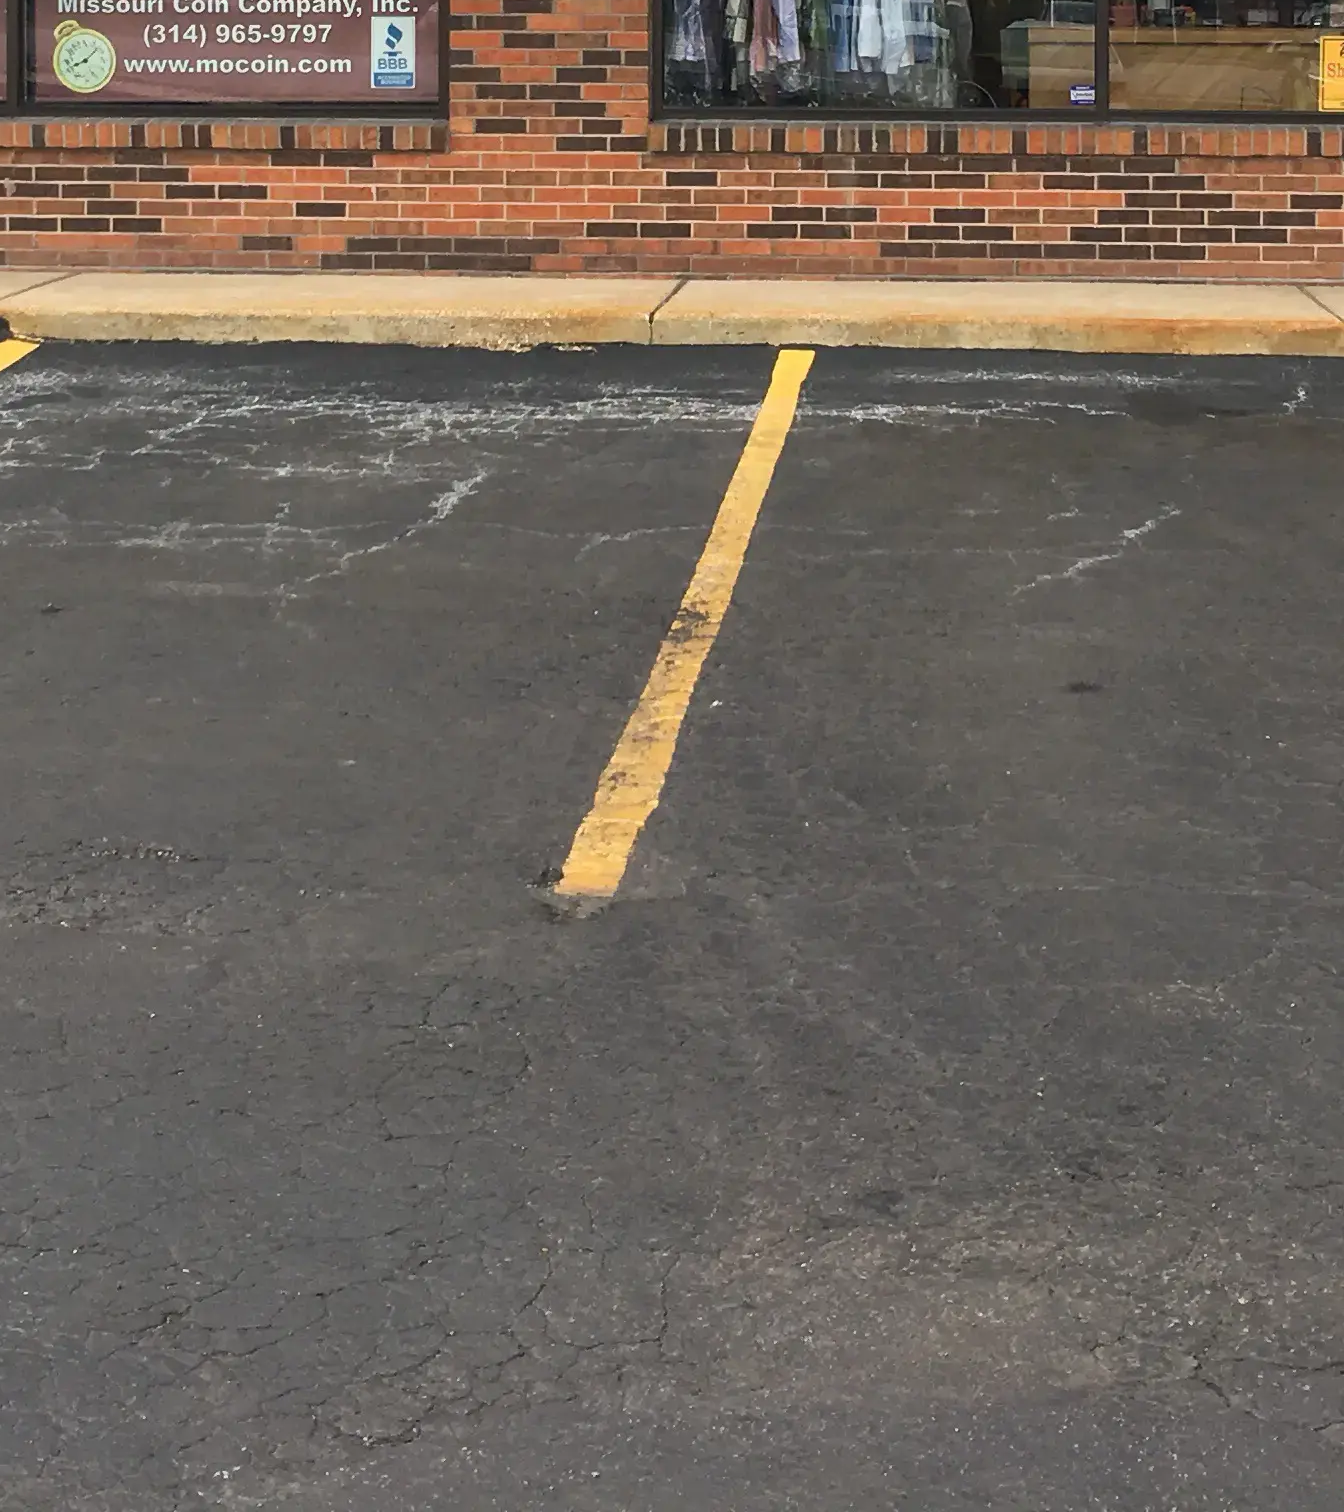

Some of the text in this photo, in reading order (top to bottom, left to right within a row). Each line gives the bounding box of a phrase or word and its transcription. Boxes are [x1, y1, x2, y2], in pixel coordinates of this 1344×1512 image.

[143, 23, 332, 48] (314) 965-9797
[123, 55, 352, 74] www.mocoin.com
[378, 58, 408, 70] BBB
